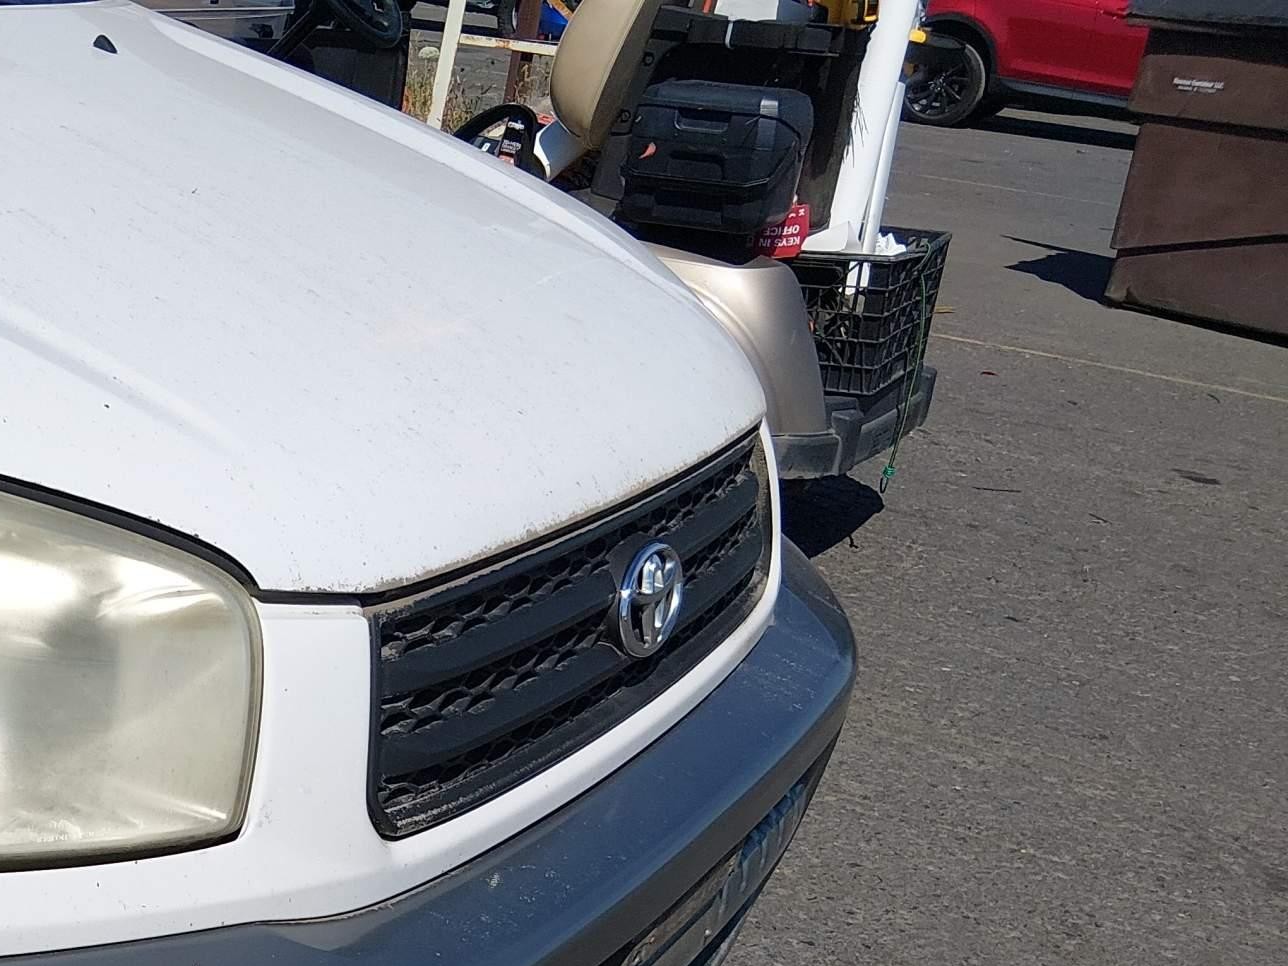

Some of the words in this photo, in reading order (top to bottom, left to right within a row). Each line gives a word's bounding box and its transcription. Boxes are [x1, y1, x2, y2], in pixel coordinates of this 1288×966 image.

[763, 225, 800, 236] OFFICE
[759, 238, 771, 247] IN
[774, 236, 801, 248] KEYS
